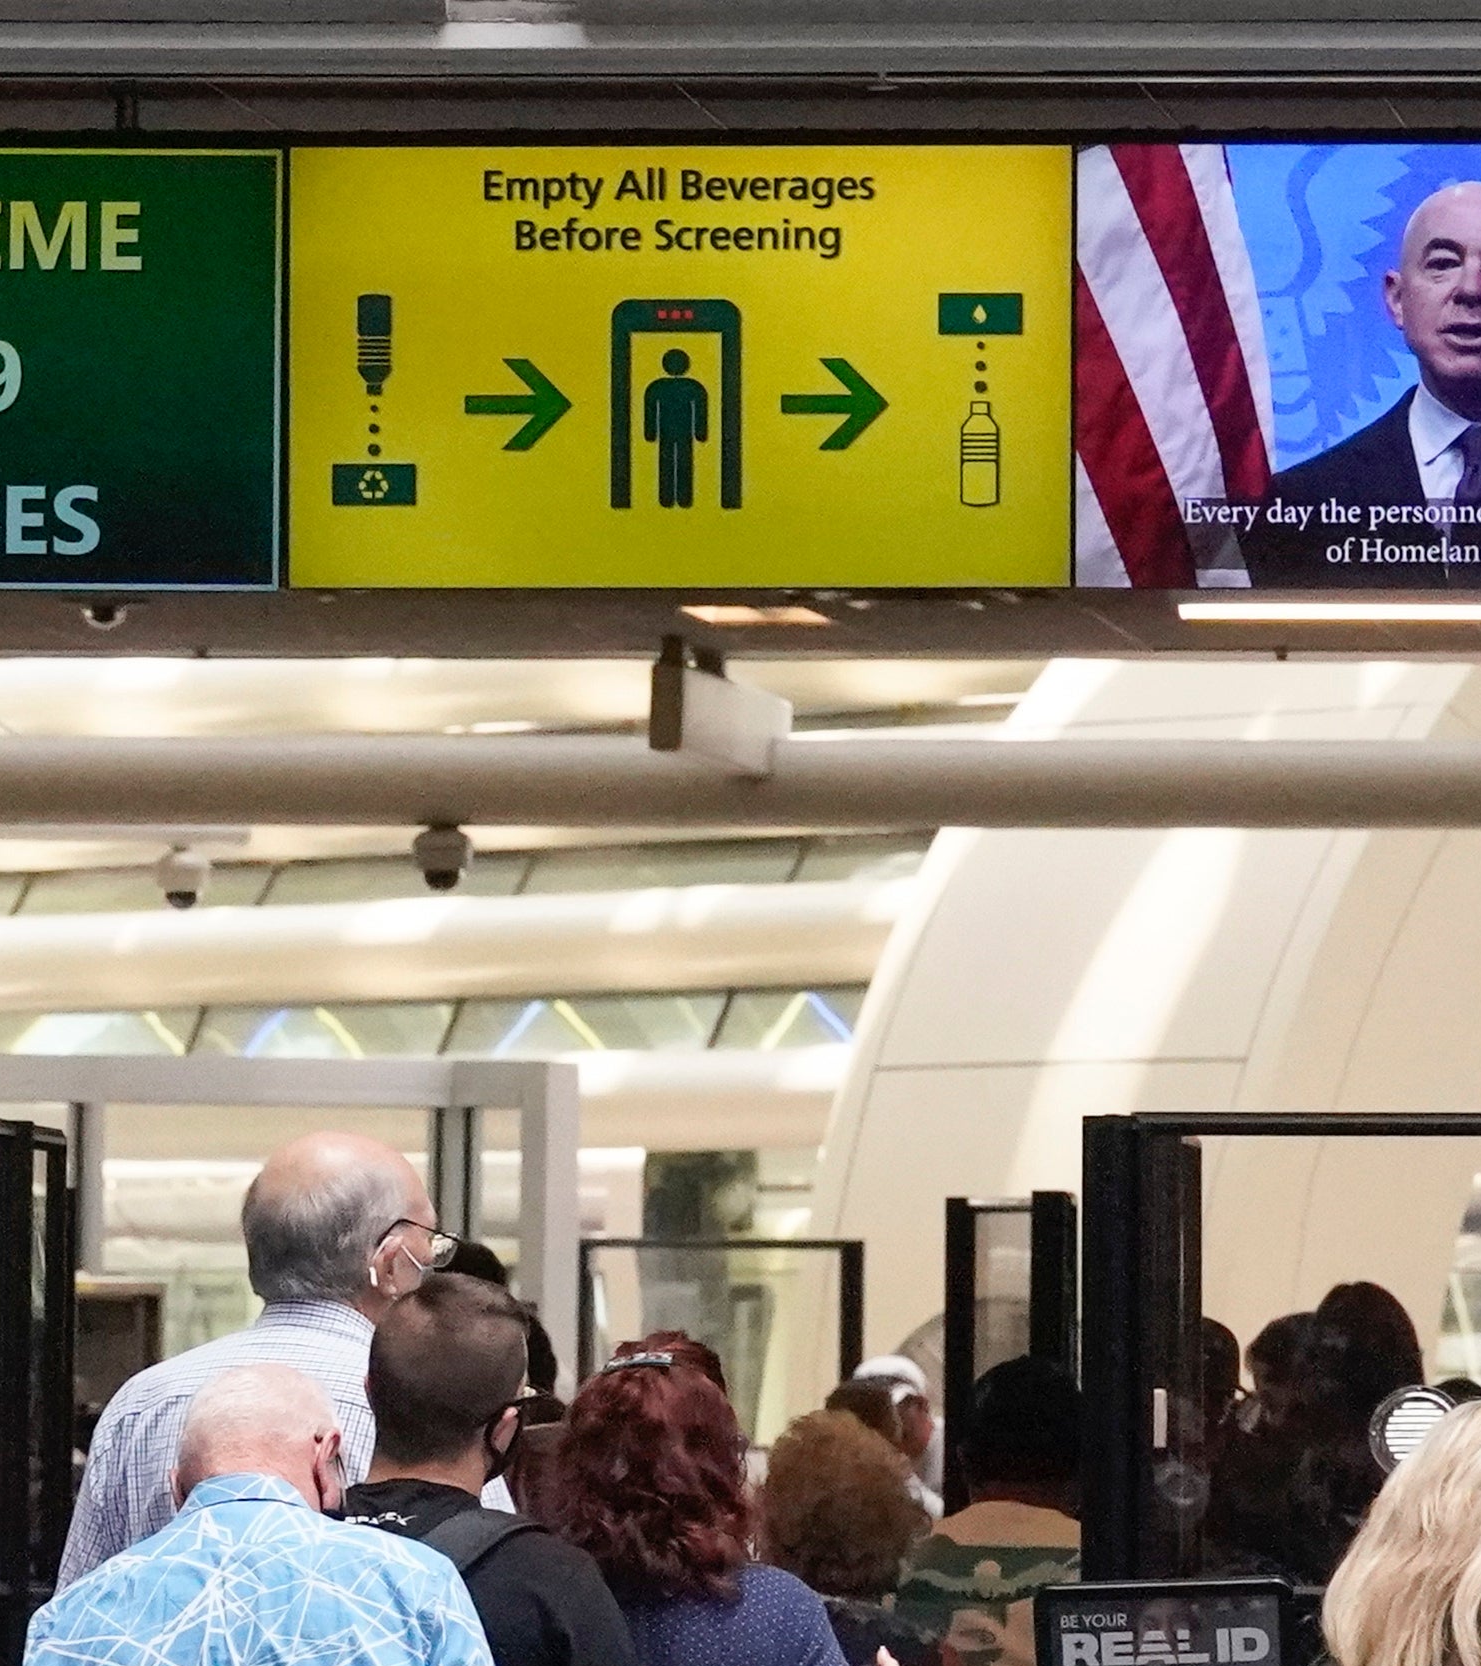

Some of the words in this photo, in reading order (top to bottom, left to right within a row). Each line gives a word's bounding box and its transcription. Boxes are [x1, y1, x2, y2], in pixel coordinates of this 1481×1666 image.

[484, 170, 603, 209] Empty
[615, 167, 666, 200] All
[681, 169, 875, 209] Beverages
[516, 218, 641, 251] Before
[655, 219, 841, 259] Screening
[1185, 499, 1259, 531] Every
[1266, 497, 1314, 531] day
[1320, 499, 1362, 524] the
[1325, 537, 1355, 563] of
[1060, 1614, 1078, 1627] BE
[1083, 1613, 1128, 1627] YOUR
[1216, 1627, 1270, 1663] ID
